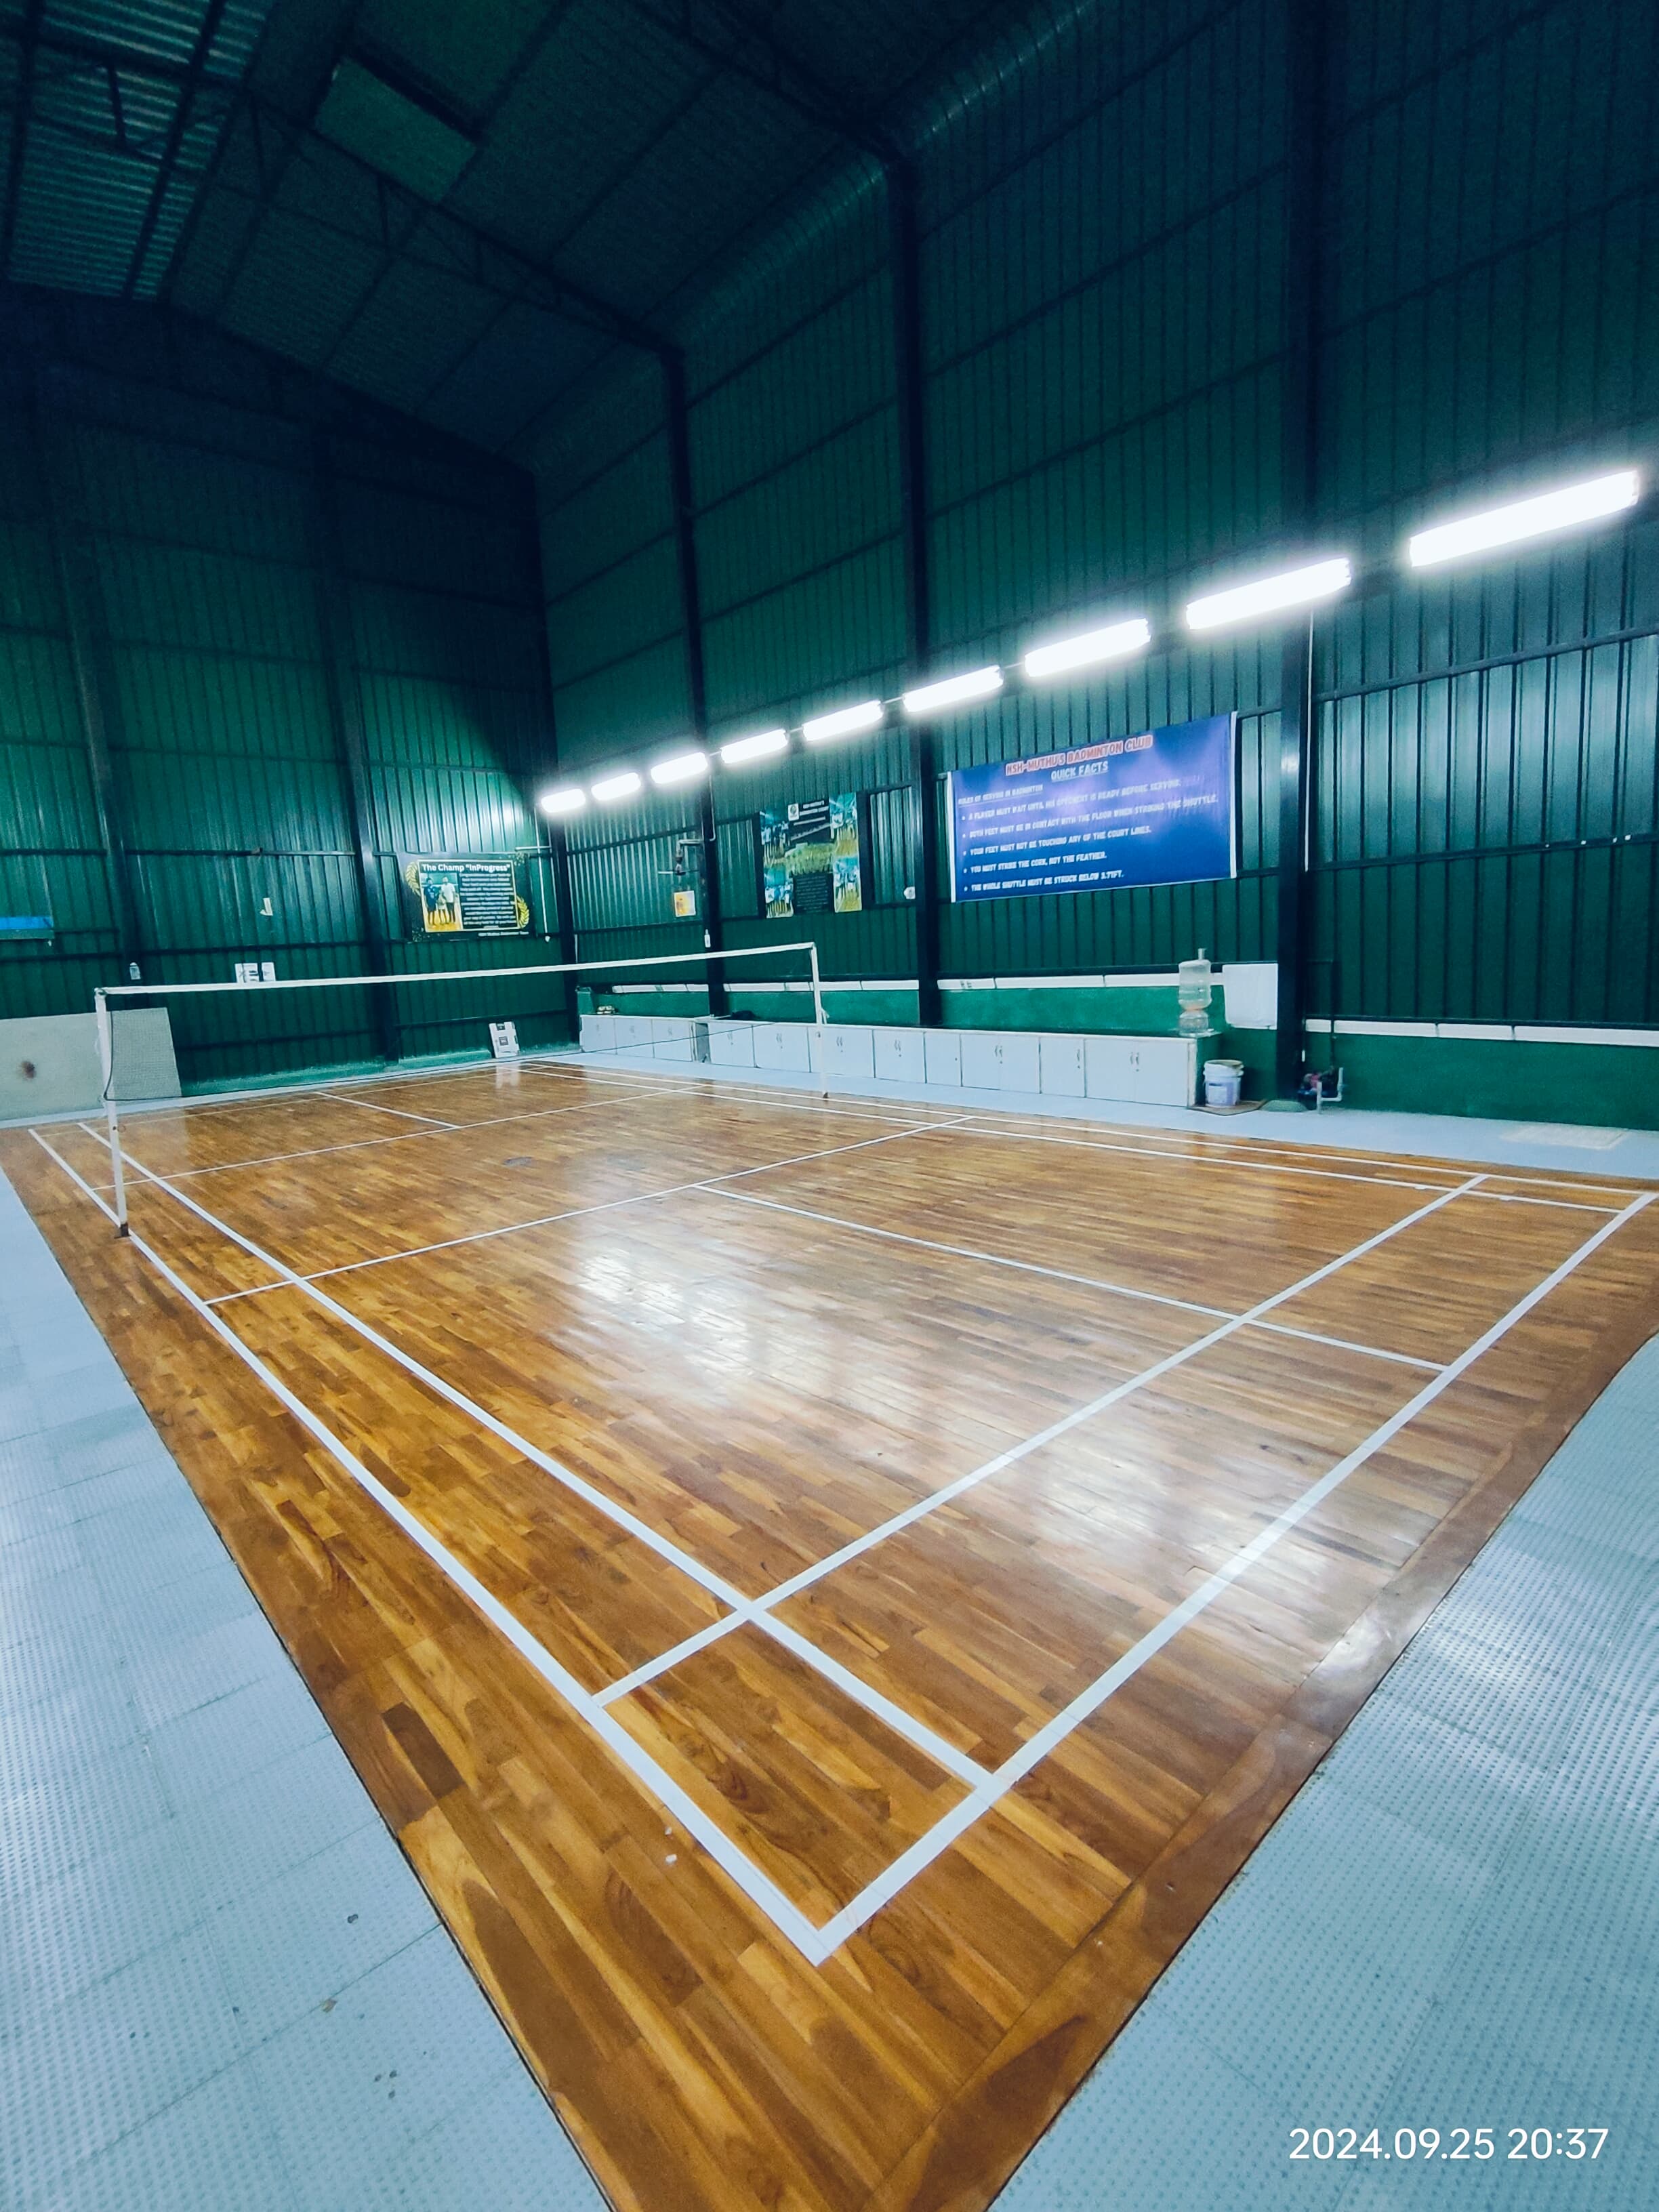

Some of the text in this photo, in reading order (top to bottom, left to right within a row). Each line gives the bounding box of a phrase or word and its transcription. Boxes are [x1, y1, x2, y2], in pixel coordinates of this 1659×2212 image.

[1066, 741, 1124, 764] BADMINTON
[1124, 735, 1153, 752] CLUB
[1051, 760, 1108, 780] QUICK FACTS
[975, 810, 995, 819] PLAYER
[996, 807, 1010, 815] MUST
[1012, 804, 1027, 813] WAIT
[1098, 789, 1120, 800] READY
[985, 827, 998, 836] FEET
[1000, 825, 1014, 834] MUST
[1032, 818, 1059, 829] CONTACT
[1061, 817, 1076, 825] WITH
[1079, 814, 1090, 822] THE
[1092, 811, 1111, 821] FLOOR
[1166, 800, 1181, 810] THE
[985, 846, 999, 854] FEET
[1000, 844, 1015, 852] MUST
[1038, 837, 1067, 847] TOUCHING
[1067, 835, 1081, 844] ANY
[1092, 832, 1106, 840] THE
[1107, 828, 1129, 838] COURT
[438, 863, 465, 873] Champ
[998, 861, 1017, 870] STRIKE
[1019, 860, 1029, 868] THE
[1063, 855, 1075, 863] THE
[1002, 880, 1026, 888] SHUTTLE
[1027, 878, 1043, 886] MUST
[1054, 875, 1077, 884] STRUCK
[1078, 872, 1099, 882] BELOW
